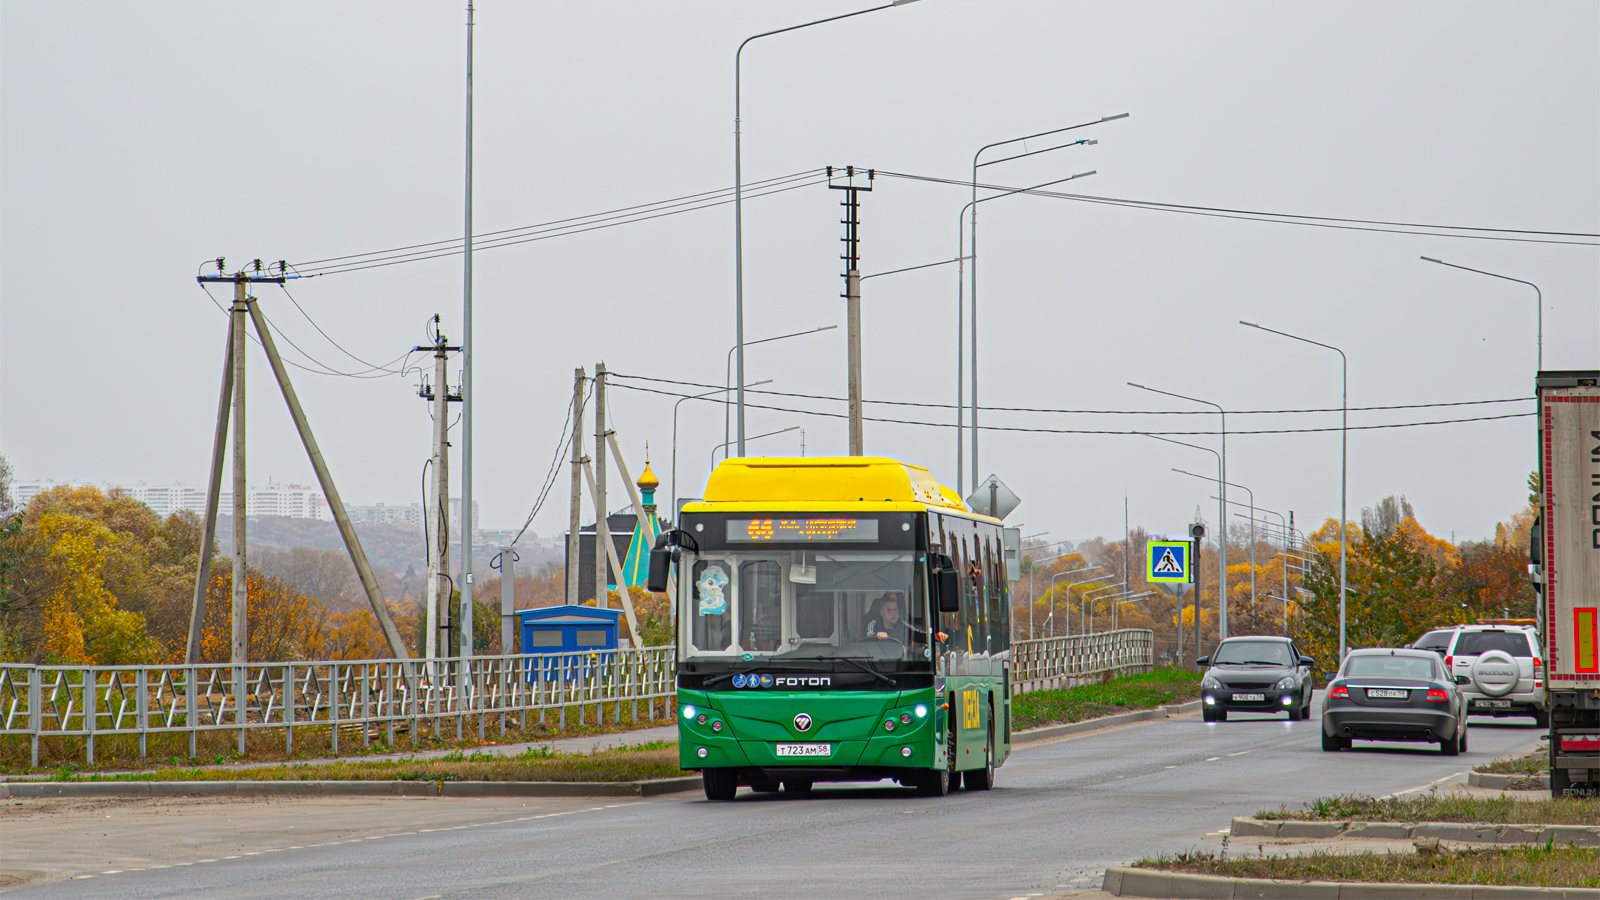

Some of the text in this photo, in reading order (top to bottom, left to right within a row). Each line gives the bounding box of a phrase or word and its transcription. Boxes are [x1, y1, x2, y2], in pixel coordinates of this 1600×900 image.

[776, 677, 831, 686] FOTON
[963, 689, 981, 729] ПЕНЗА
[1563, 788, 1597, 796] BONUM
